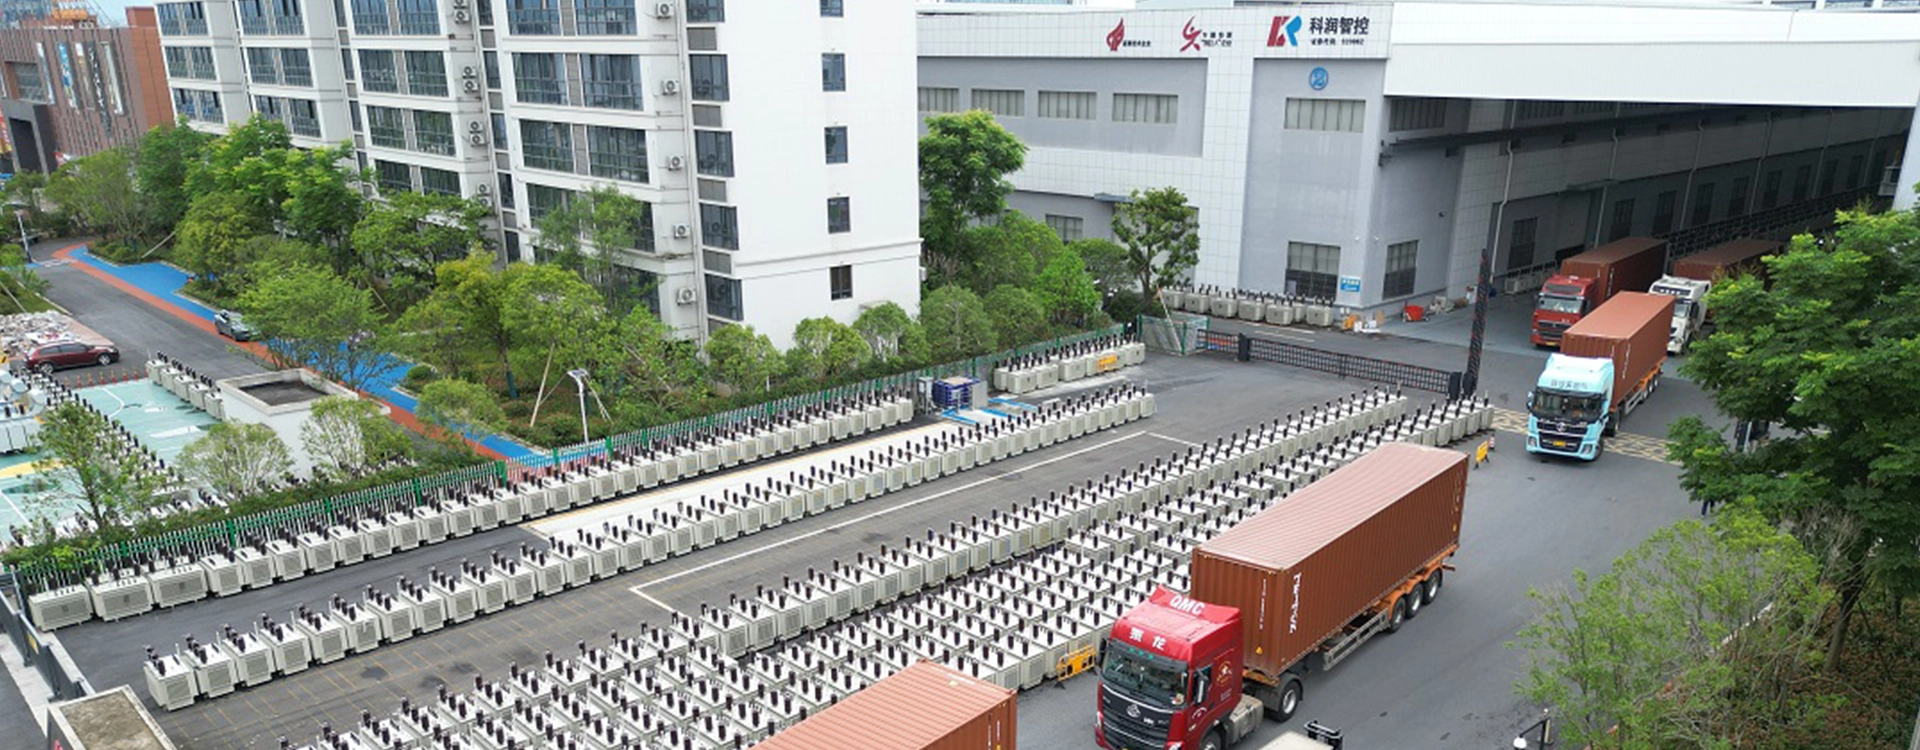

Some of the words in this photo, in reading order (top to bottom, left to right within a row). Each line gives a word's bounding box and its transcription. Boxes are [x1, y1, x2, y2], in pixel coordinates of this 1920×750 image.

[1309, 16, 1369, 35] 科润智控
[1169, 594, 1205, 615] QMC
